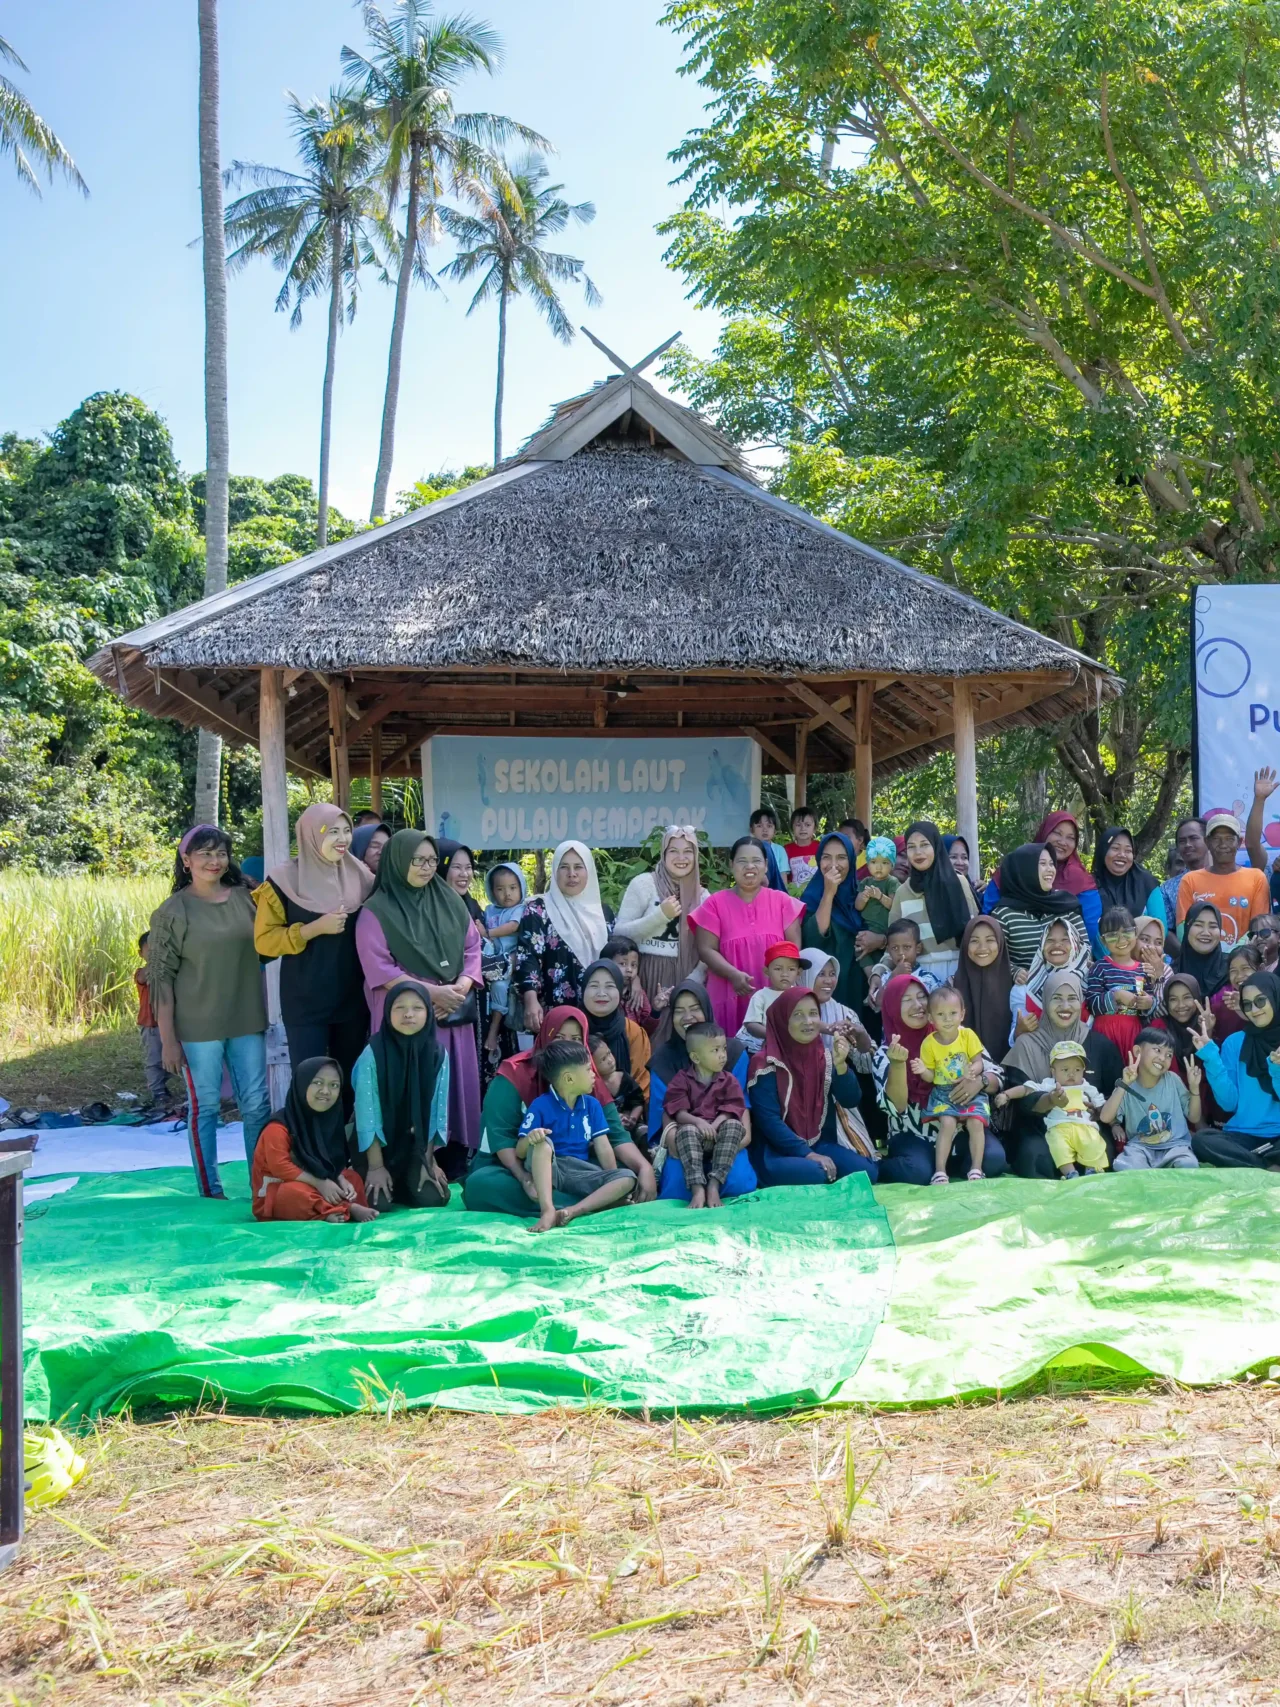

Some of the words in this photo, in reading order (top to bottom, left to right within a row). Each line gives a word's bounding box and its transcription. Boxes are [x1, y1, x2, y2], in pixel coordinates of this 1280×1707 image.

[496, 759, 610, 793] SEKOLAH
[618, 759, 685, 792] LAUT
[482, 808, 569, 841] PULAU
[640, 938, 665, 948] LOUIS
[522, 1112, 534, 1129] 3
